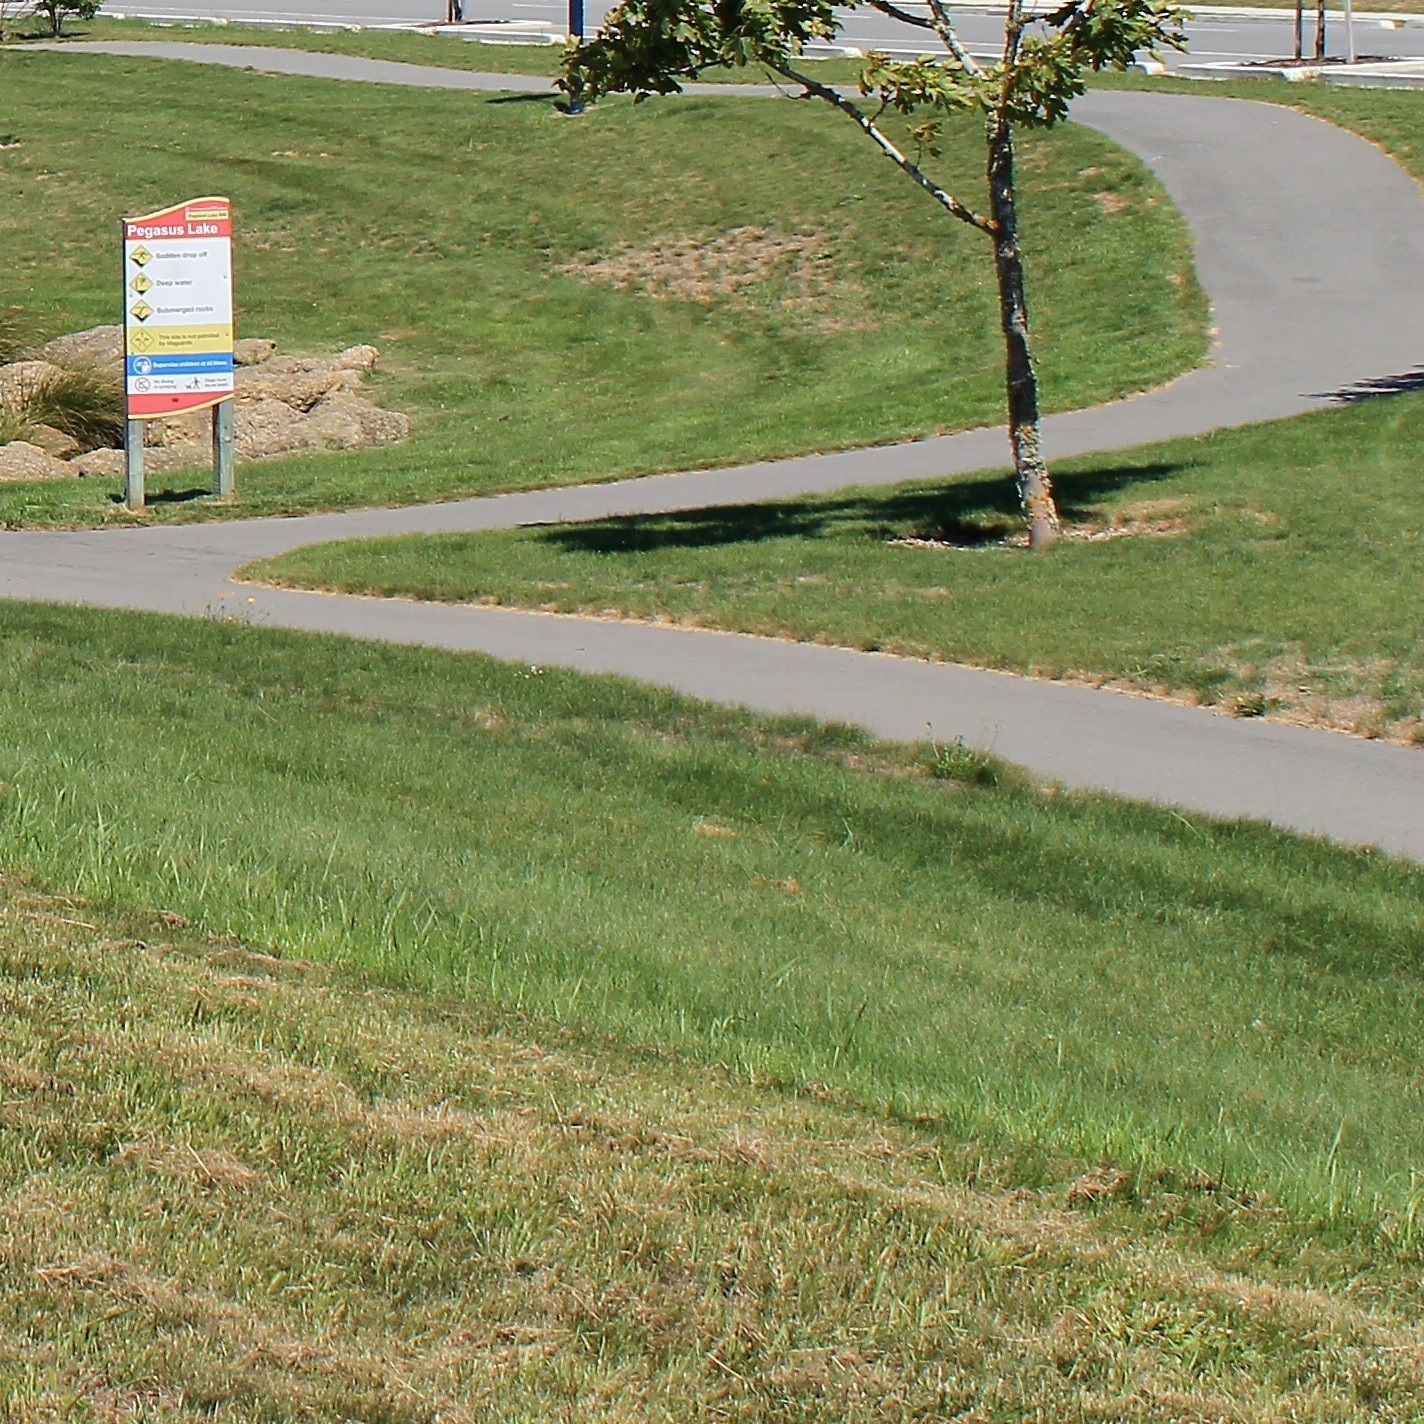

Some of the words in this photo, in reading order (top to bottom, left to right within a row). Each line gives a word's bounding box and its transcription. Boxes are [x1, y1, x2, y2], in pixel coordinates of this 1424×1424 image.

[127, 224, 185, 239] Pegasus
[187, 223, 218, 235] Lake
[156, 306, 194, 314] Submerged
